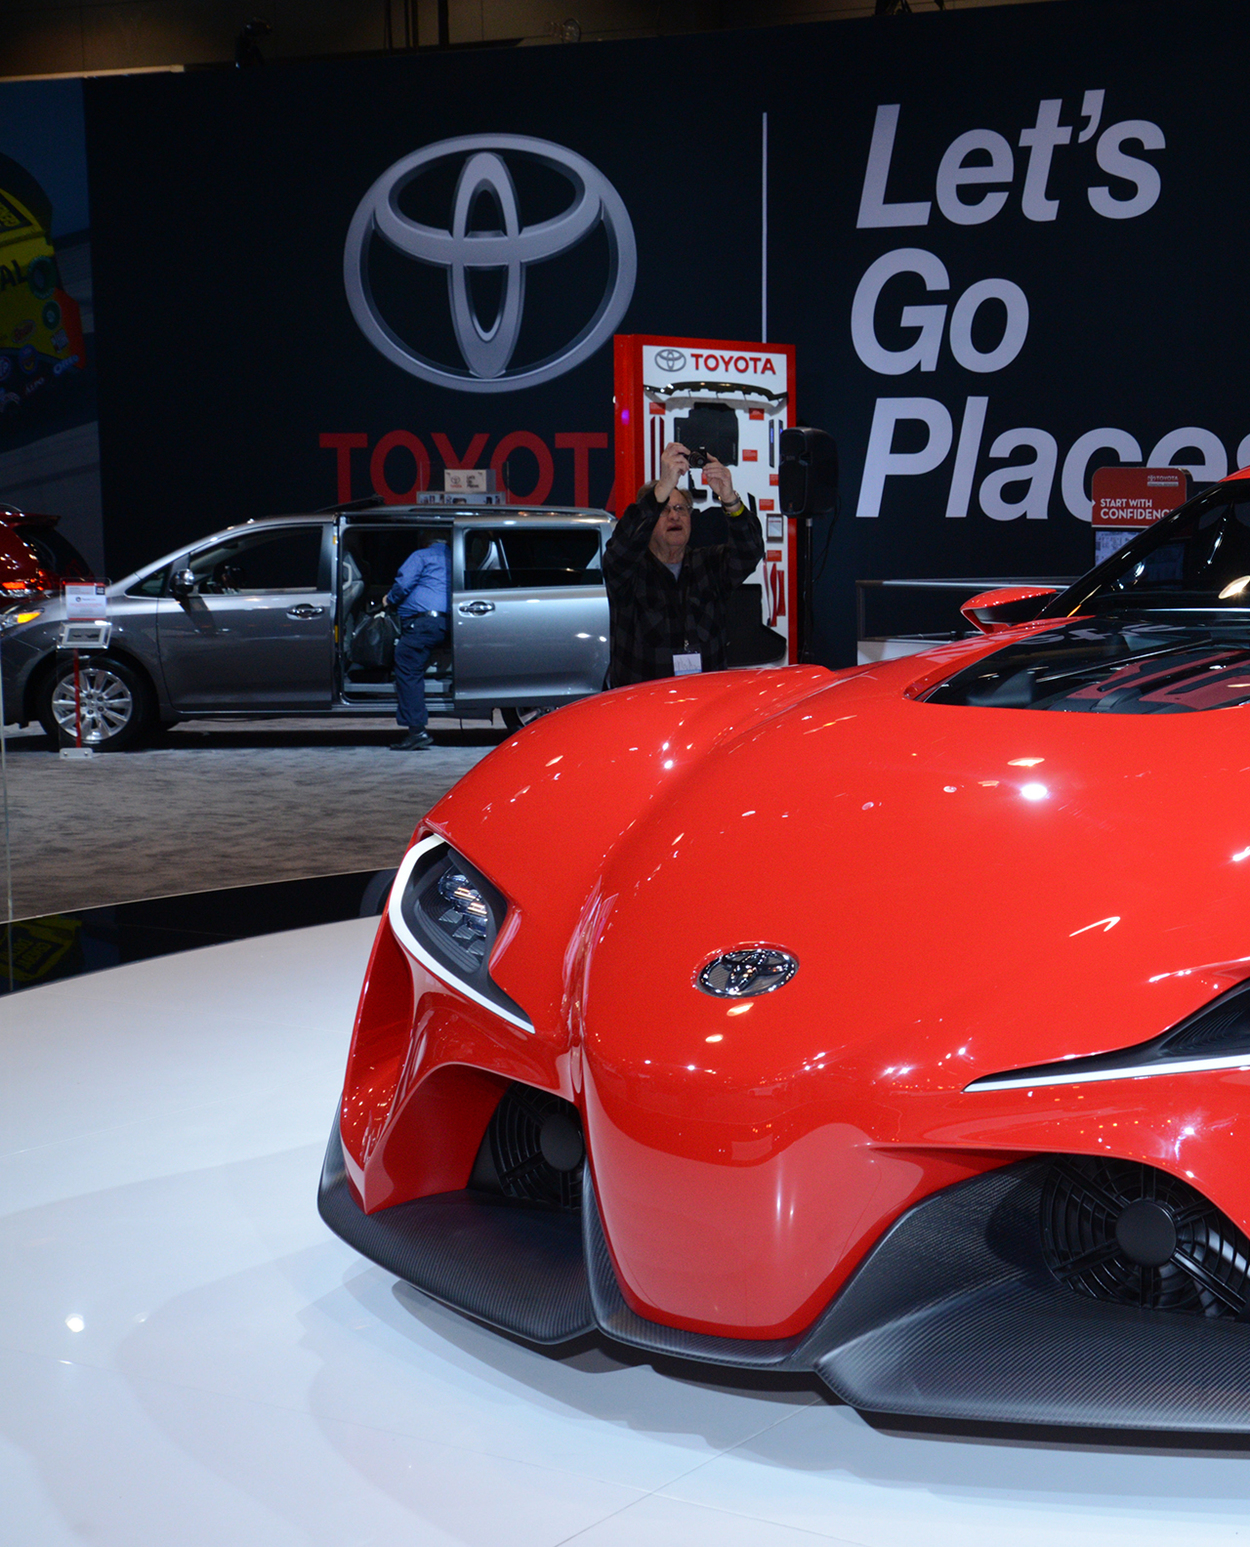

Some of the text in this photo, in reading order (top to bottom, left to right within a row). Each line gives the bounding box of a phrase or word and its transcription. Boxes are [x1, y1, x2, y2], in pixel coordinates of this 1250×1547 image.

[856, 89, 1167, 229] Let's
[851, 247, 1030, 376] Go
[690, 353, 776, 375] TOYOTA
[319, 429, 615, 507] TOYOT
[1100, 498, 1153, 507] START WITH
[1100, 508, 1174, 520] CONFIDENC
